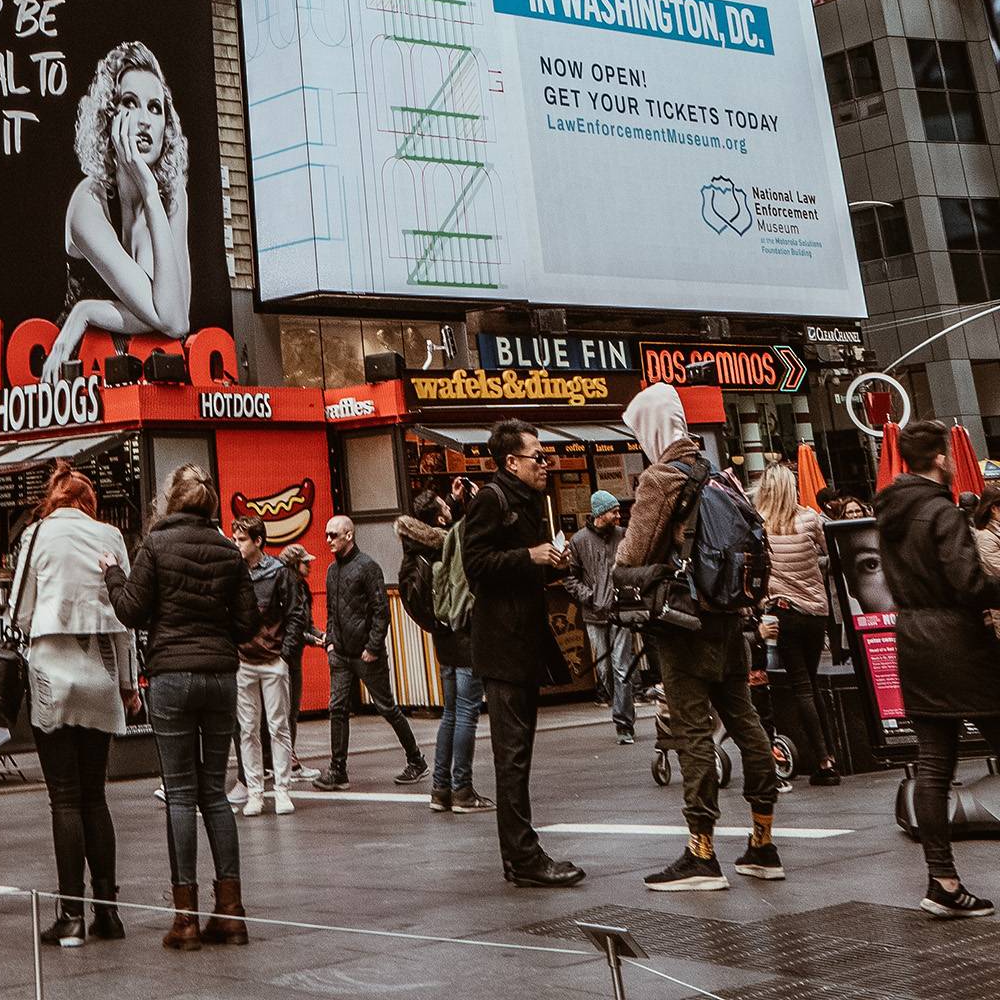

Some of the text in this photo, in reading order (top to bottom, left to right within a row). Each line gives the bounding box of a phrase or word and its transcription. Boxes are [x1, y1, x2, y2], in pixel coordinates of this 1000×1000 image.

[29, 51, 68, 97] TO
[539, 56, 648, 88] NOW OPEN!
[544, 85, 778, 133] GET YOUR TICKETS TODAY
[2, 109, 40, 155] IT
[546, 114, 748, 154] LawEnforcementMuseum.org
[752, 186, 816, 205] National Law
[754, 202, 819, 220] Enforcement
[757, 219, 800, 235] Museum
[761, 246, 790, 255] Foundation
[496, 337, 627, 369] BLUE FIN
[646, 350, 686, 384] DOS
[411, 369, 608, 406] wafels&dinges
[201, 392, 273, 418] HOTDOGS
